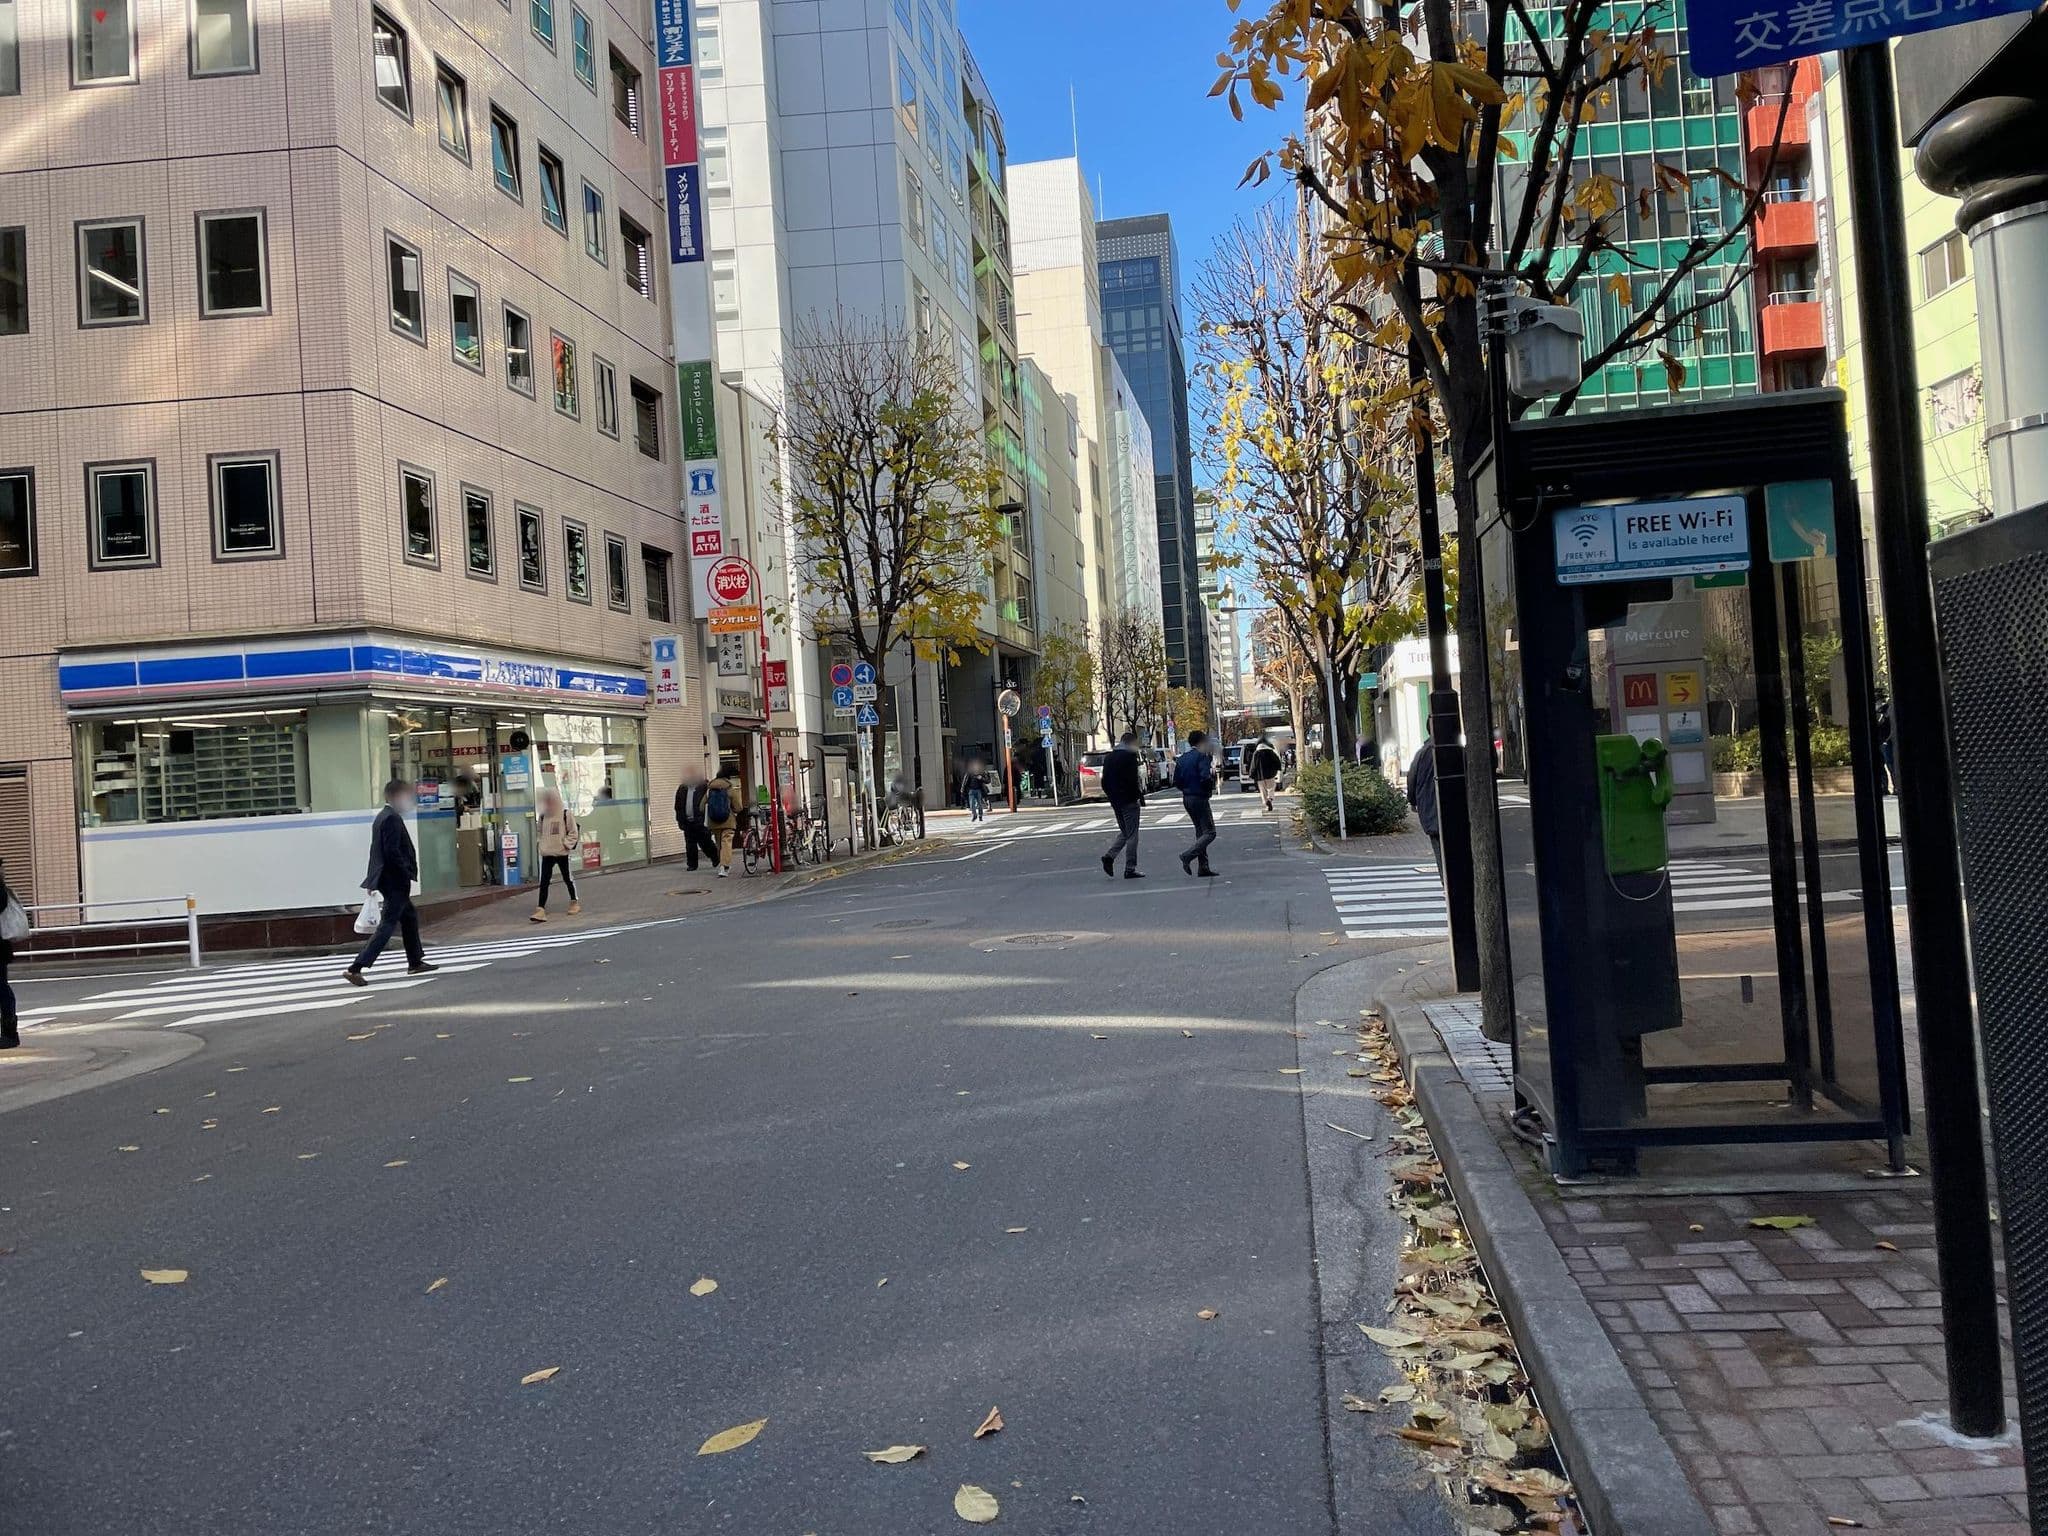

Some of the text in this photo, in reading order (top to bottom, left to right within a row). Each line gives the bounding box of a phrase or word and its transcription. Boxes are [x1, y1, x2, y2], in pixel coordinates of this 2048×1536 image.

[1734, 0, 1996, 60] 交差点
[696, 416, 704, 444] Green
[691, 515, 720, 526] たばこ
[1626, 509, 1733, 534] FREE Wi-Fi
[695, 542, 720, 552] ATM
[1641, 535, 1698, 549] available
[1702, 532, 1734, 544] here!
[717, 574, 748, 590] 消火栓
[1625, 629, 1690, 641] Mercure
[657, 683, 679, 692] たばこ
[837, 692, 846, 706] P
